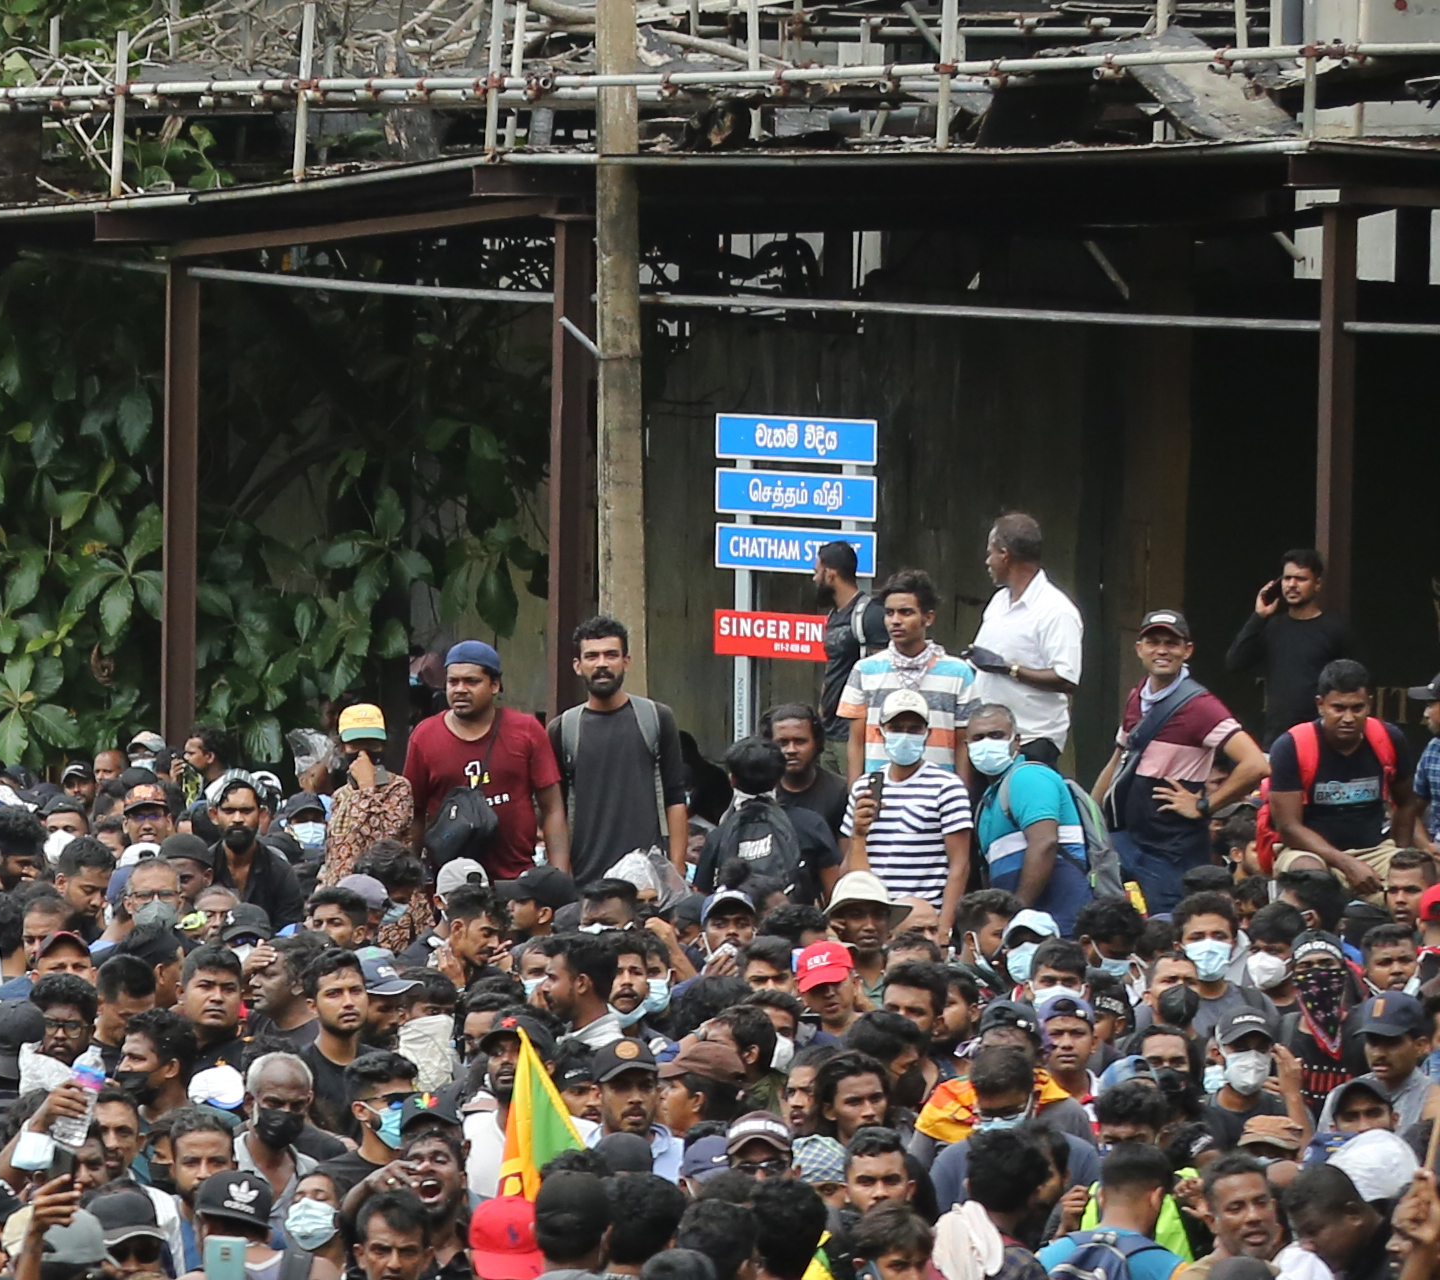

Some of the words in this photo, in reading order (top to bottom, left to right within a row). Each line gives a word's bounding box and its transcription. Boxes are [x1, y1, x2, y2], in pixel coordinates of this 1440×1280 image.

[749, 478, 808, 508] செத்தம்
[813, 481, 843, 511] வீதி
[729, 536, 800, 561] CHATHAM
[804, 540, 861, 562] STT
[719, 616, 790, 640] SINGER
[795, 622, 823, 642] FIN
